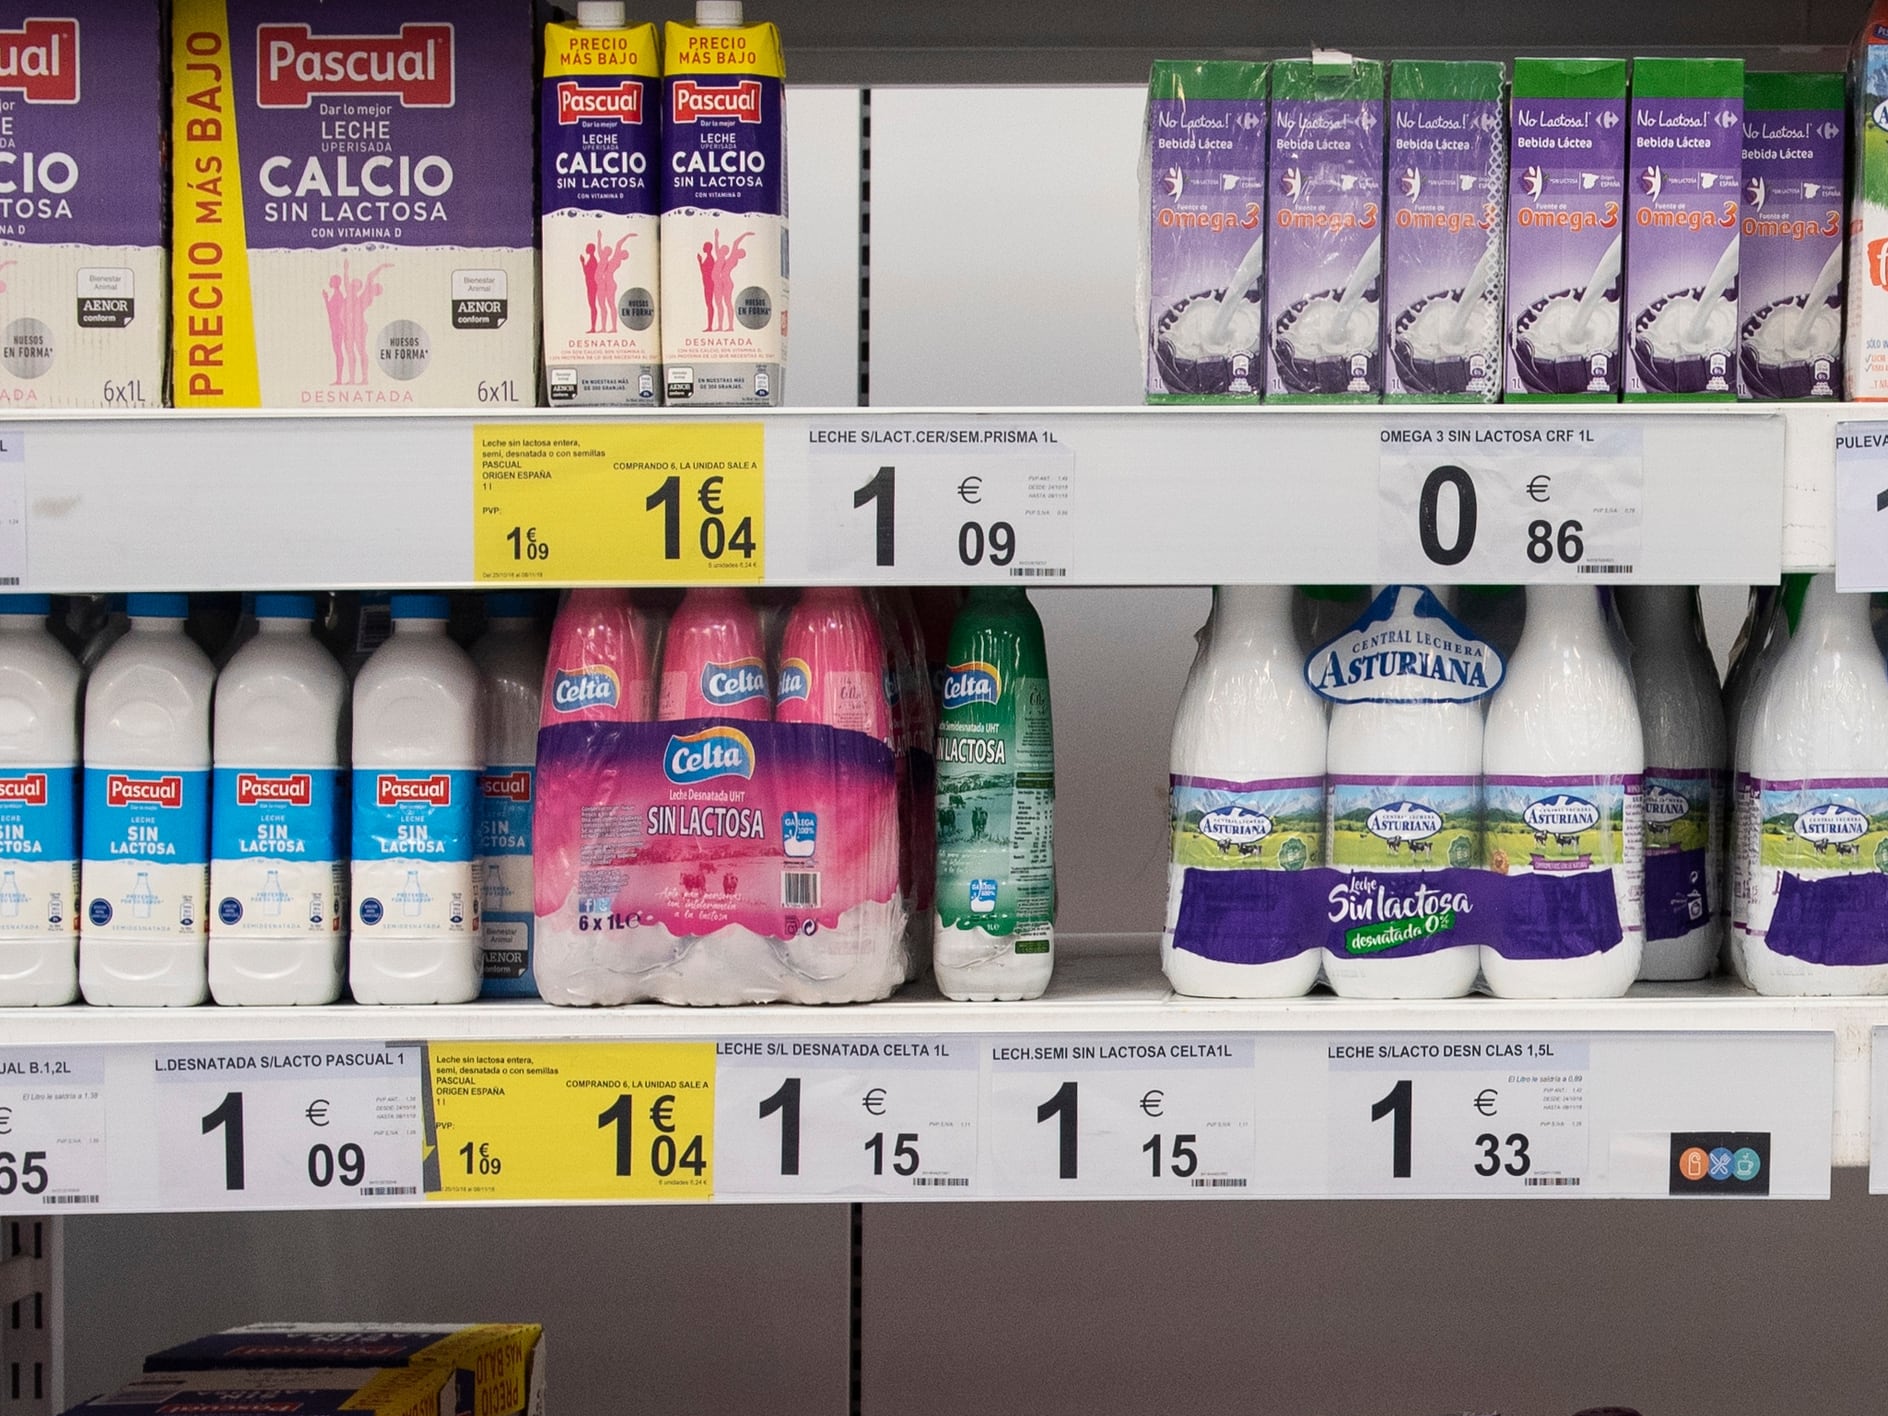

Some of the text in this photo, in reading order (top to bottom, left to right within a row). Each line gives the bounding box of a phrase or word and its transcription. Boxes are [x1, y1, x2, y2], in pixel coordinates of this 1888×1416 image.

[569, 38, 627, 50] PRECIO
[270, 40, 436, 81] Pascual
[560, 50, 638, 64] MÁS BAJO
[1637, 111, 1657, 127] No
[321, 121, 390, 139] LECHE
[1637, 136, 1712, 148] Bebida Láctea
[258, 156, 454, 198] CALCIO
[186, 30, 224, 397] PRECIO MÁS BAJO
[264, 203, 448, 222] SIN LACTOSA
[1637, 201, 1737, 231] Omega 3
[311, 228, 402, 238] CON VITAMINA D
[478, 380, 519, 403] 6x1L
[482, 439, 581, 449] Leche sin lactosa entera,
[809, 430, 1058, 444] LECHE S/LACT.CER/SEM.PRISMA 1L
[482, 461, 522, 469] PASCUAL
[482, 470, 552, 479] ORIGEN ESPAÑA
[613, 462, 758, 472] COMPRANDO 6, LA UNIDAD SALE A
[700, 516, 755, 561] 04
[1352, 630, 1483, 657] CENTRAL LECHERA
[1318, 651, 1488, 689] ASTURIANA
[672, 738, 741, 774] Celta
[111, 781, 175, 800] Pascual
[647, 806, 676, 838] SIN
[679, 808, 764, 839] LACTOSA
[127, 827, 157, 840] SIN
[111, 842, 175, 855] LACTOSA
[1350, 876, 1377, 896] Leche
[1328, 886, 1473, 923] Sin lactosa
[1352, 925, 1422, 950] desnatada
[155, 1052, 405, 1072] L.DESNATADA S/LACTO PASCUAL 1
